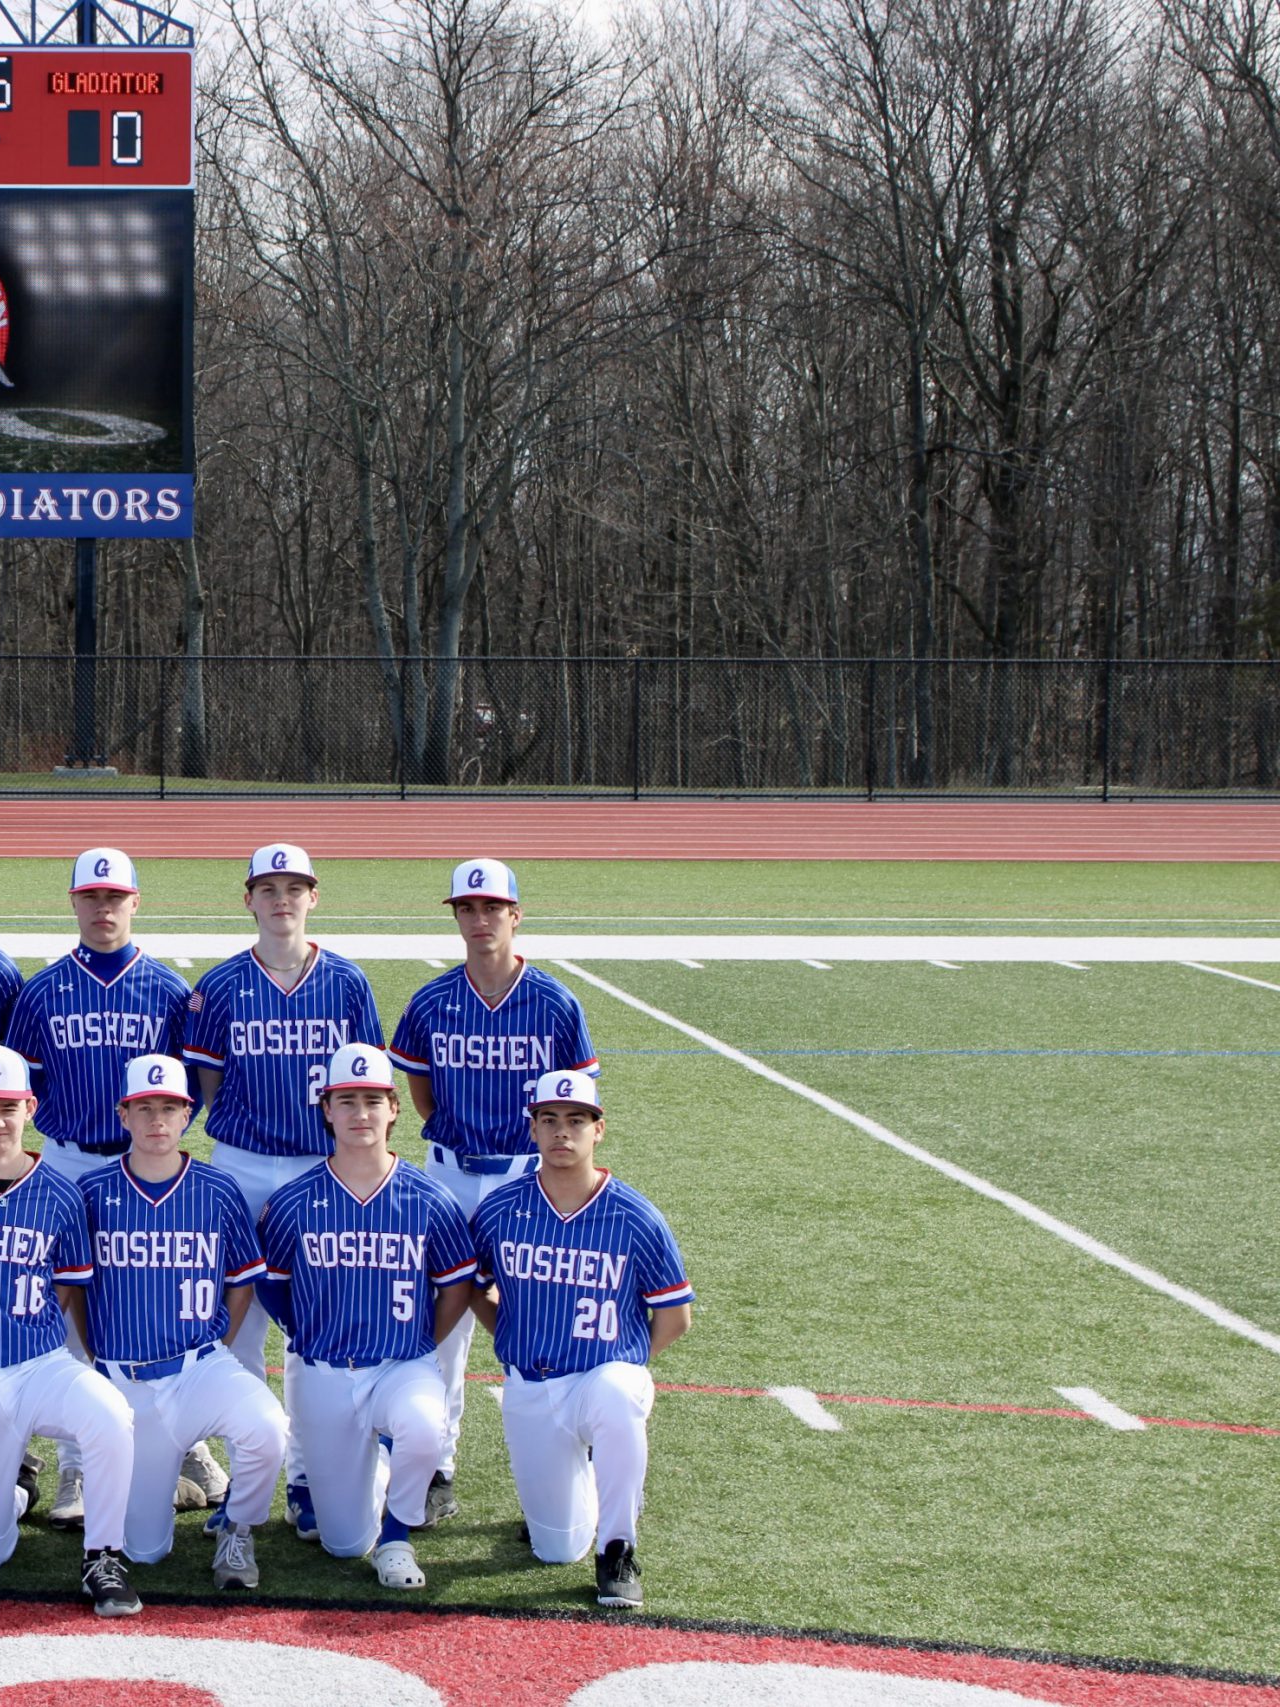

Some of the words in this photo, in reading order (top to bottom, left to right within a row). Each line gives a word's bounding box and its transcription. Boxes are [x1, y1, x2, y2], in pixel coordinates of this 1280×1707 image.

[51, 72, 160, 94] GLADIATOR
[112, 111, 142, 164] 0
[93, 858, 112, 878] G
[271, 851, 289, 869] G
[467, 869, 485, 889] G
[49, 1011, 163, 1050] GOSHEN
[229, 1019, 349, 1056] GOSHEN
[351, 1056, 370, 1077] G
[431, 1032, 553, 1071] GOSHEN
[147, 1065, 167, 1085] G
[555, 1079, 574, 1098] G
[95, 1231, 218, 1268] GOSHEN
[302, 1232, 425, 1270] GOSHEN
[500, 1241, 626, 1290] GOSHEN
[12, 1274, 46, 1315] 16
[179, 1278, 214, 1320] 10
[392, 1280, 415, 1322] 5
[572, 1298, 618, 1341] 20
